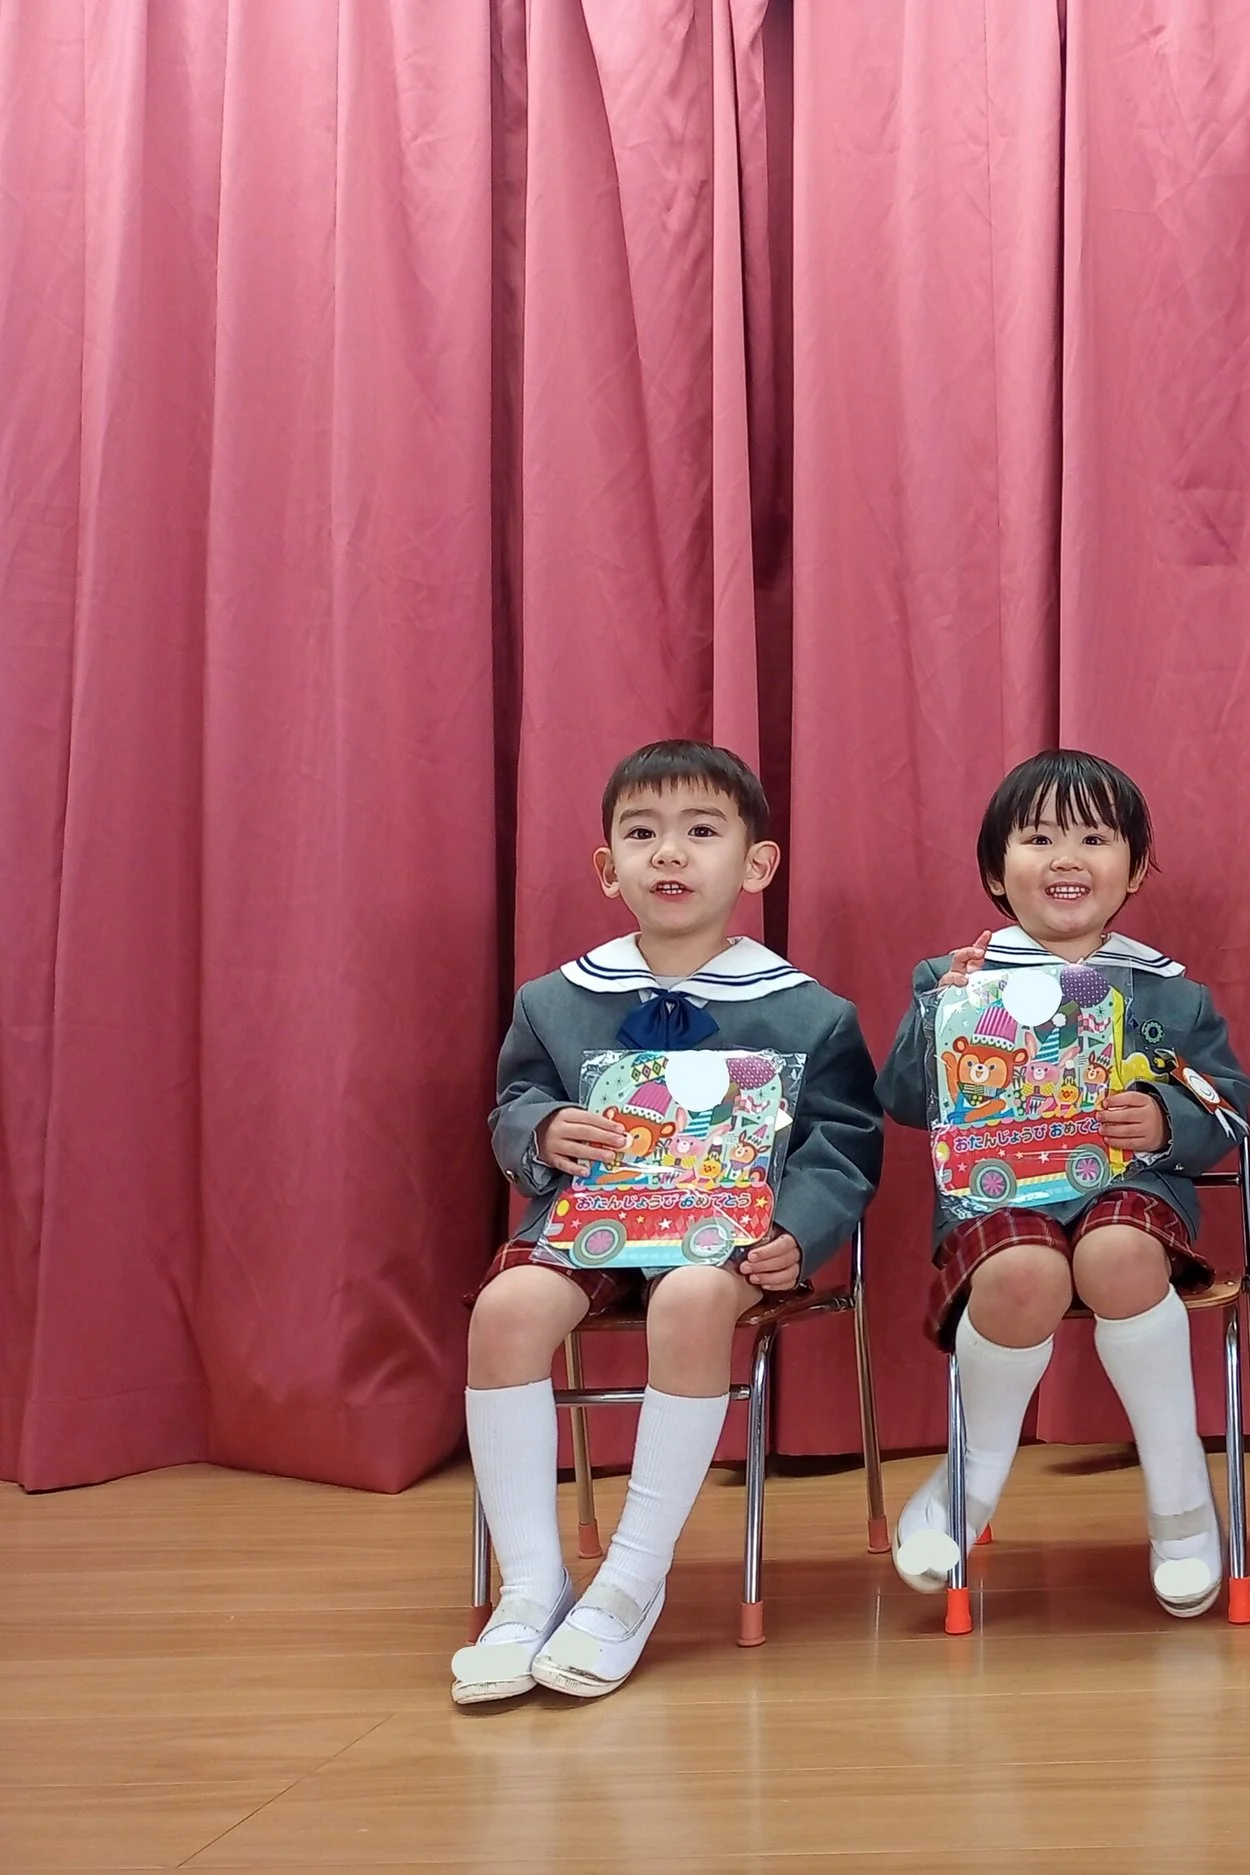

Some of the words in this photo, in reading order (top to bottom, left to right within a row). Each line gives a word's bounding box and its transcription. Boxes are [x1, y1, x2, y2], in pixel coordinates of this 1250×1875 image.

[954, 1123, 1047, 1152] おたんじょうび
[1050, 1118, 1101, 1138] おめでと
[576, 1194, 679, 1211] おたんじょうび
[680, 1193, 751, 1210] おめでとう
